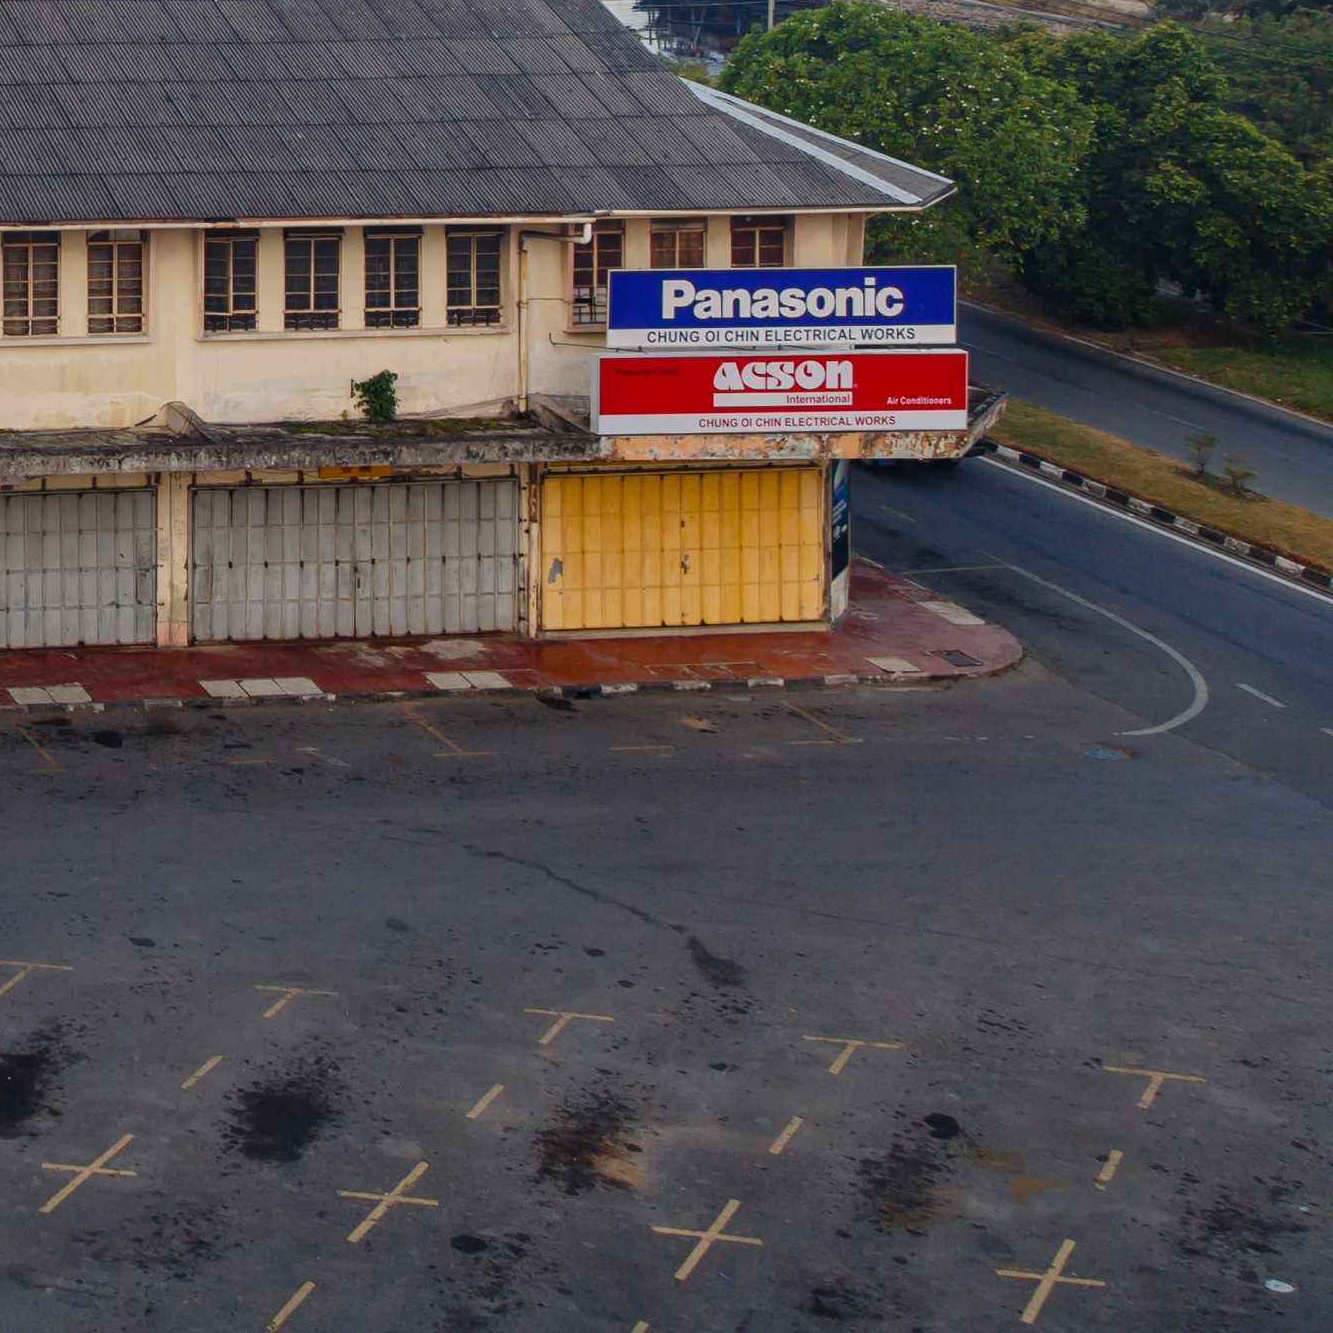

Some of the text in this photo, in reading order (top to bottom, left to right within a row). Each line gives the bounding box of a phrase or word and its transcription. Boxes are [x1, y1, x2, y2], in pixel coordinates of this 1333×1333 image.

[662, 277, 904, 320] Panasonic
[647, 327, 916, 344] CHUNG OI CHIN ELECTRICAL WORKS
[786, 394, 851, 404] International
[887, 396, 952, 406] Air Conditioners
[699, 415, 896, 429] CHUNG OI CHIN ELECTRICAL WORKS
